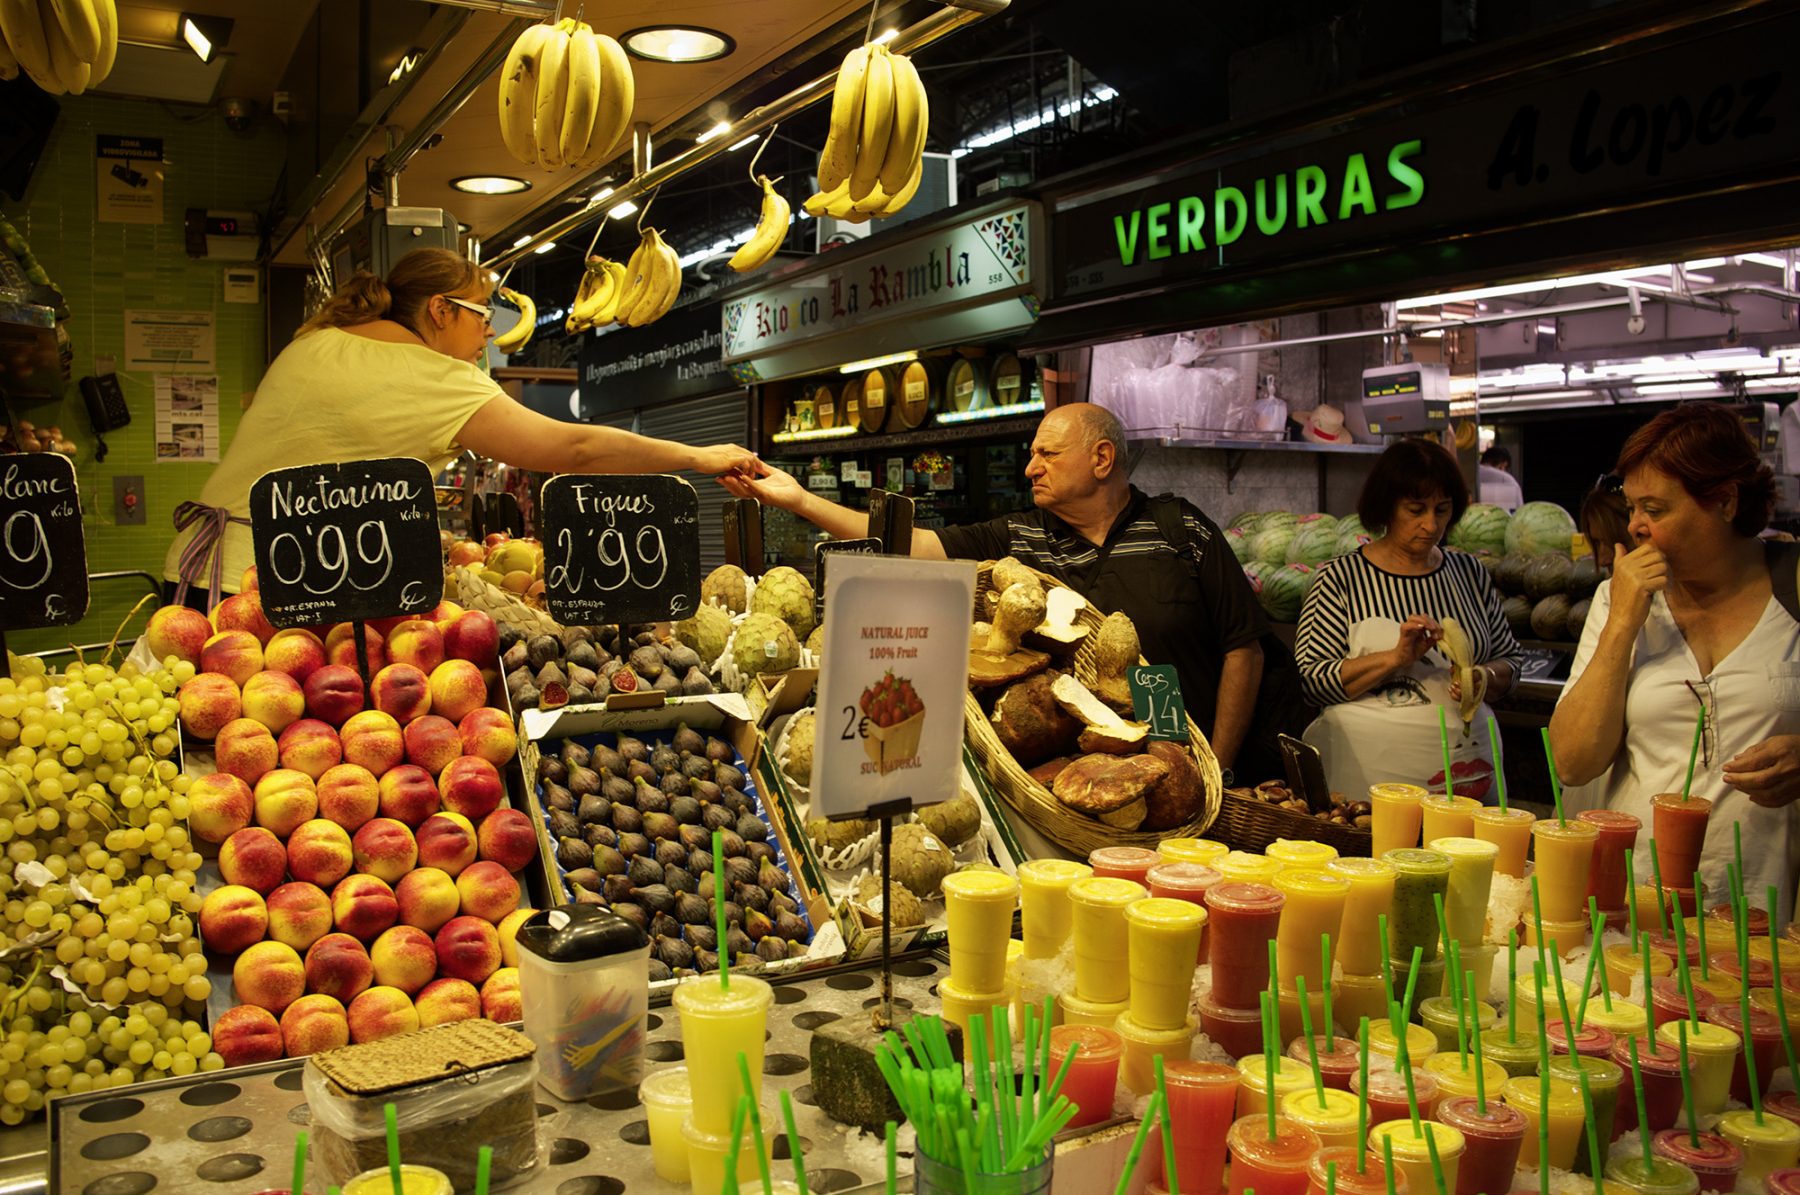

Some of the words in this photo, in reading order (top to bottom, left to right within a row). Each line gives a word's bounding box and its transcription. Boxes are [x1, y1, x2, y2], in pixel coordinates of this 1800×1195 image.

[1486, 104, 1550, 191] A.
[1568, 70, 1783, 176] Lopez
[1112, 138, 1425, 266] VERDURAS
[756, 295, 820, 340] Kiosco
[828, 273, 859, 319] La
[867, 243, 972, 310] Rambla
[987, 272, 1003, 285] 558
[0, 464, 70, 500] lanc
[271, 474, 422, 520] Nectarina
[51, 501, 74, 518] Kilo
[400, 504, 421, 521] Kilo
[571, 483, 656, 528] Figues
[269, 520, 394, 595] 0'99
[549, 525, 669, 594] 2'99
[860, 626, 904, 640] NATURAL
[904, 626, 929, 641] JUICE
[869, 646, 895, 660] 100%
[896, 646, 918, 659] Fruit
[1134, 668, 1169, 694] Ceps
[617, 718, 659, 727] Moreno
[860, 761, 878, 775] SUC
